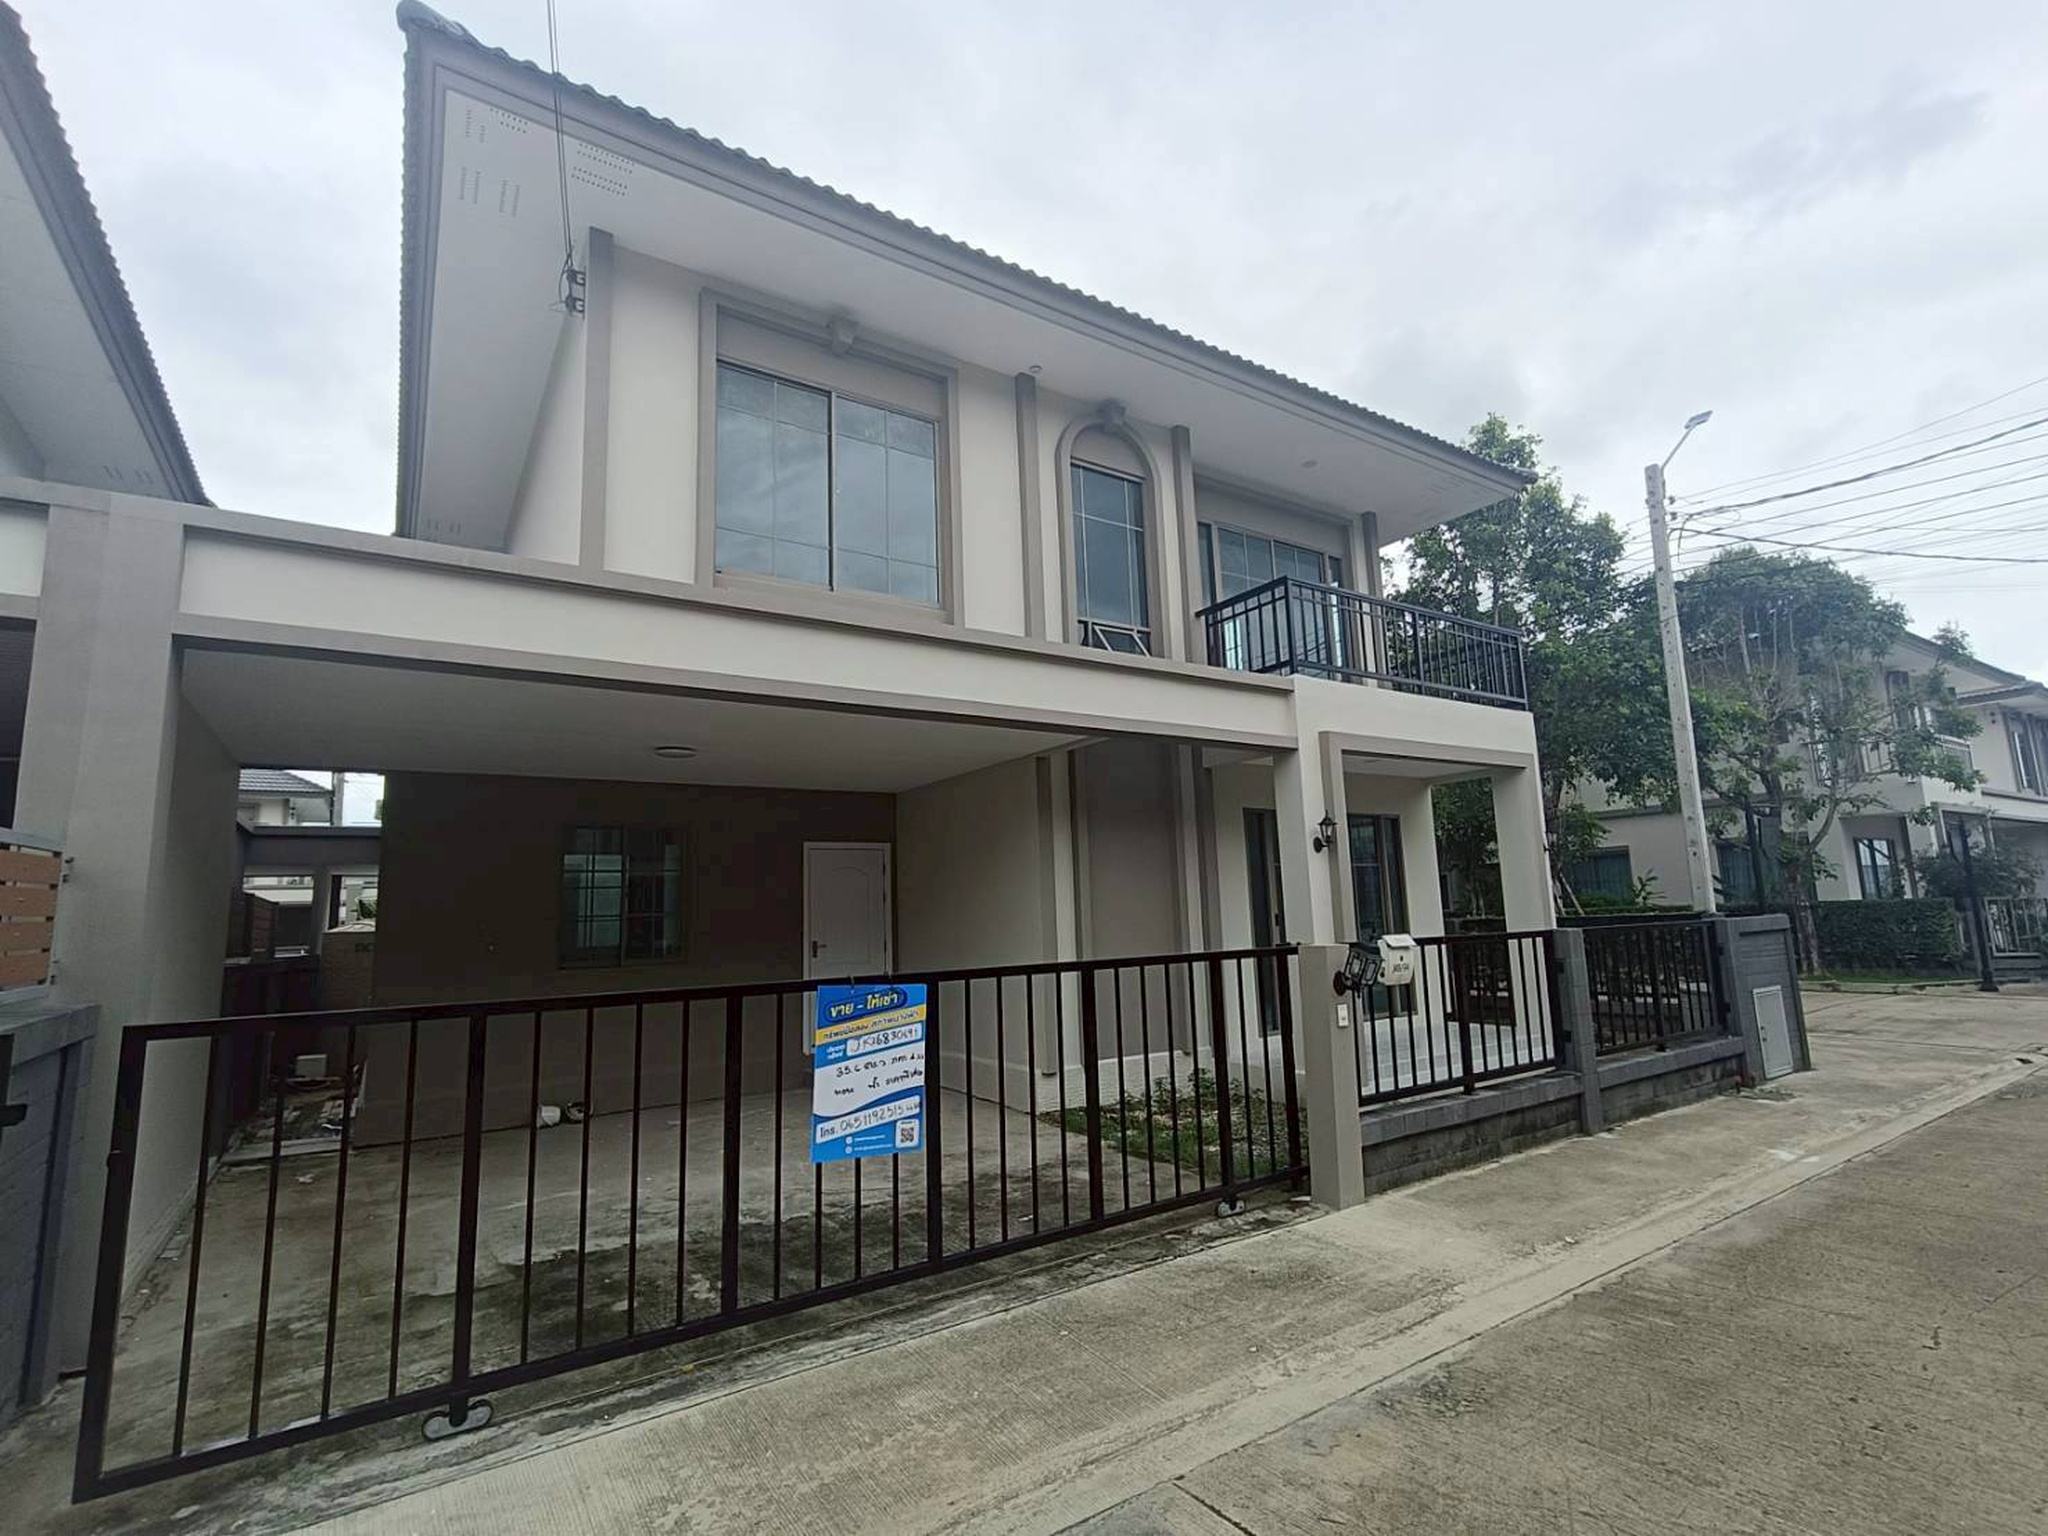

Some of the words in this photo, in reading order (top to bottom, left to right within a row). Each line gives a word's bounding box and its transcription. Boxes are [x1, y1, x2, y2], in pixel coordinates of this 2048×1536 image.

[830, 1003, 854, 1018] ขาย
[866, 991, 898, 1010] ให้เช่า
